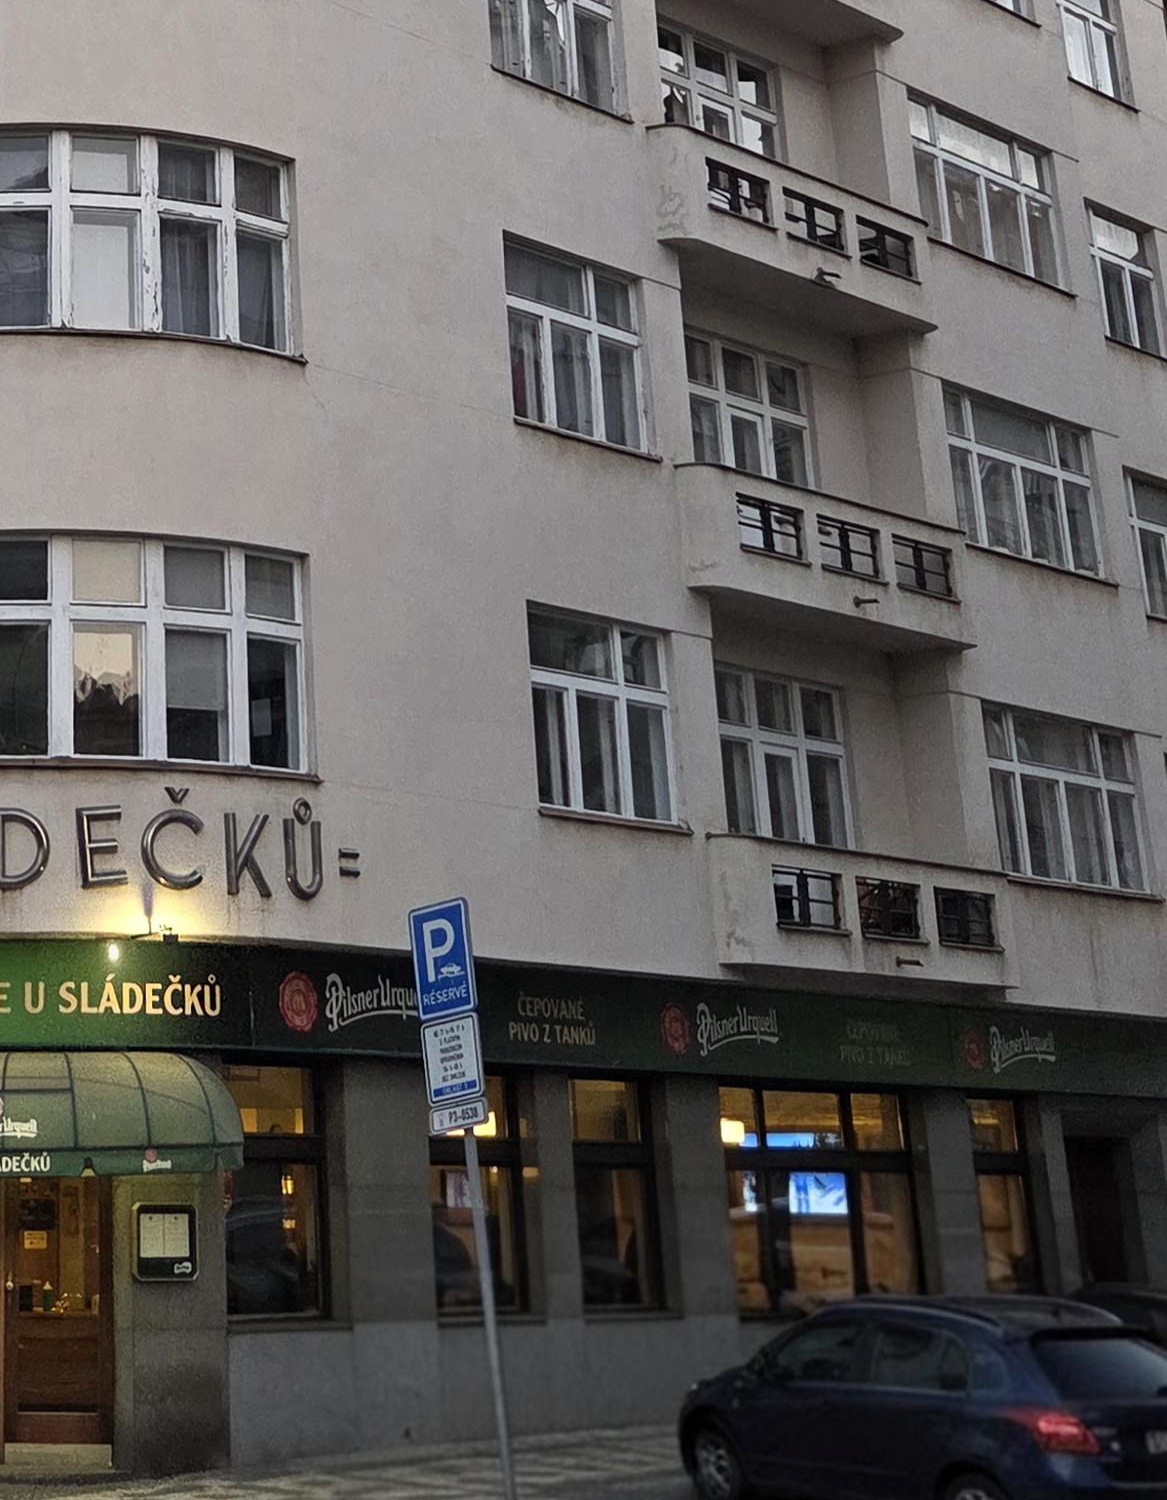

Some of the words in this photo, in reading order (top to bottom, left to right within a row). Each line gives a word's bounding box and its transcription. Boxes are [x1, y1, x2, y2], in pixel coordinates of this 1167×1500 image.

[422, 918, 455, 983] P
[24, 982, 45, 1014] U
[58, 973, 222, 1017] SLÁDEČKŮ
[325, 972, 380, 1033] Pilsner
[422, 981, 468, 1006] RÉSERVÉ
[517, 991, 585, 1020] ČEPOVANÉ
[509, 1021, 539, 1043] PIVO
[542, 1023, 551, 1043] Z
[554, 1020, 595, 1045] TANKŮ
[696, 1002, 738, 1057] Pilsner
[737, 1004, 779, 1044] Urquell
